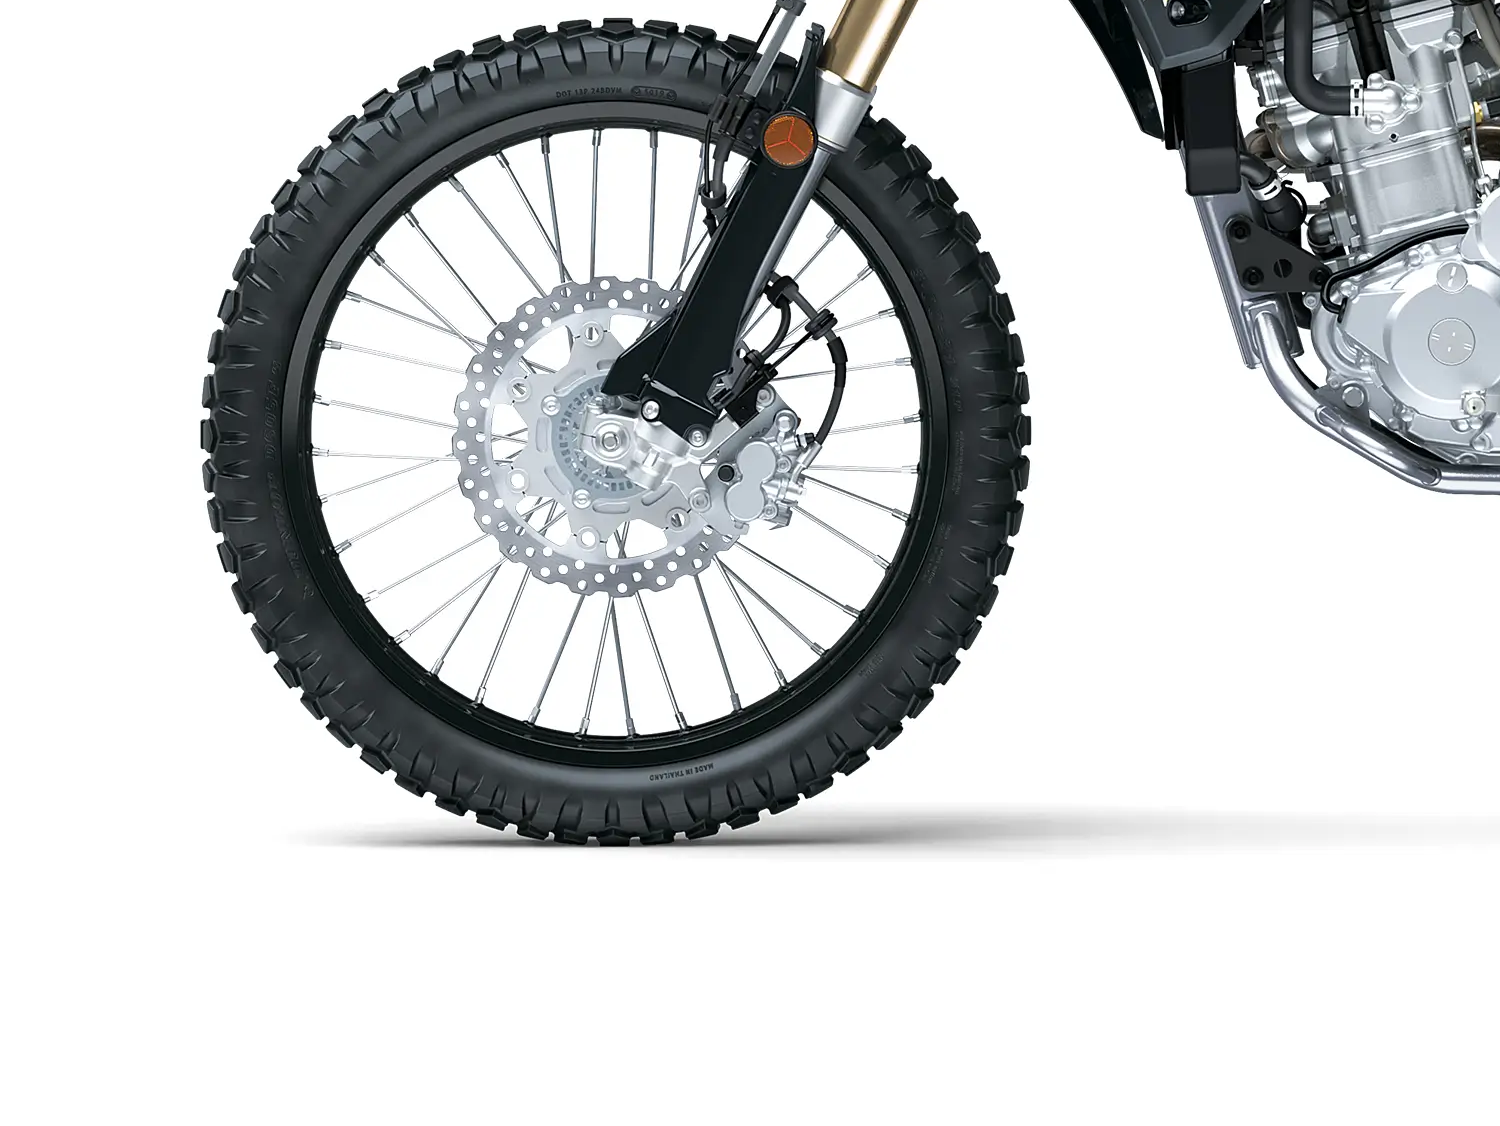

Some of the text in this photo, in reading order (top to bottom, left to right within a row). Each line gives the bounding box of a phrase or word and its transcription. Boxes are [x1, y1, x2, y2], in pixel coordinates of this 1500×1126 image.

[556, 90, 572, 98] DOT
[695, 763, 714, 773] MADE
[649, 770, 684, 781] THAILAND
